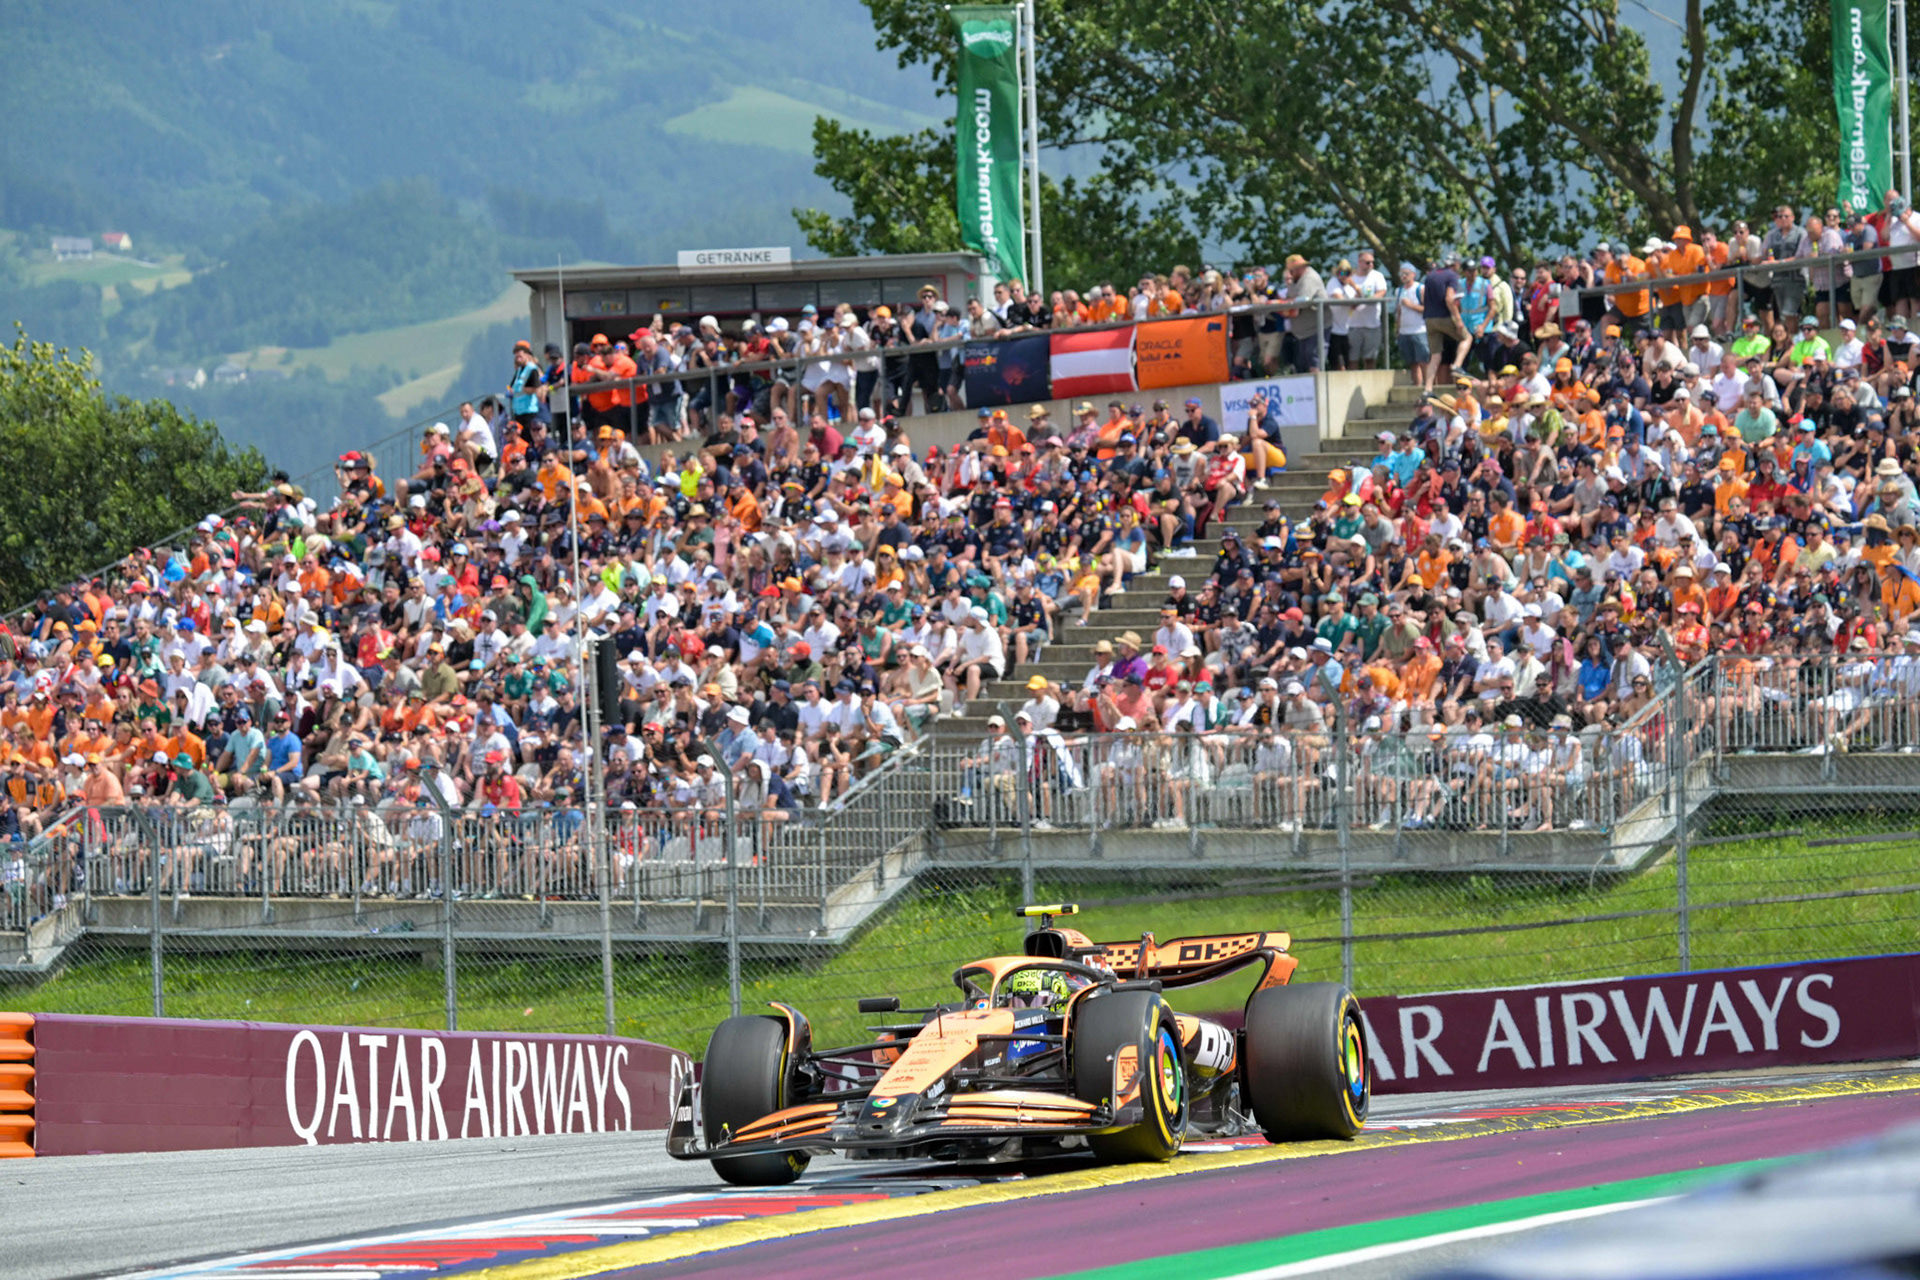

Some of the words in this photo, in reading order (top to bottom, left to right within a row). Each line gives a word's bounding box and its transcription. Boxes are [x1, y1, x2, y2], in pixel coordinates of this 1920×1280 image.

[696, 250, 772, 264] GETRÄNKE
[1140, 339, 1183, 350] ORACLE
[1224, 399, 1249, 412] VISA
[1477, 974, 1840, 1073] AIRWAYS
[286, 1030, 449, 1146] QATAR
[461, 1038, 632, 1138] AIRWAYS
